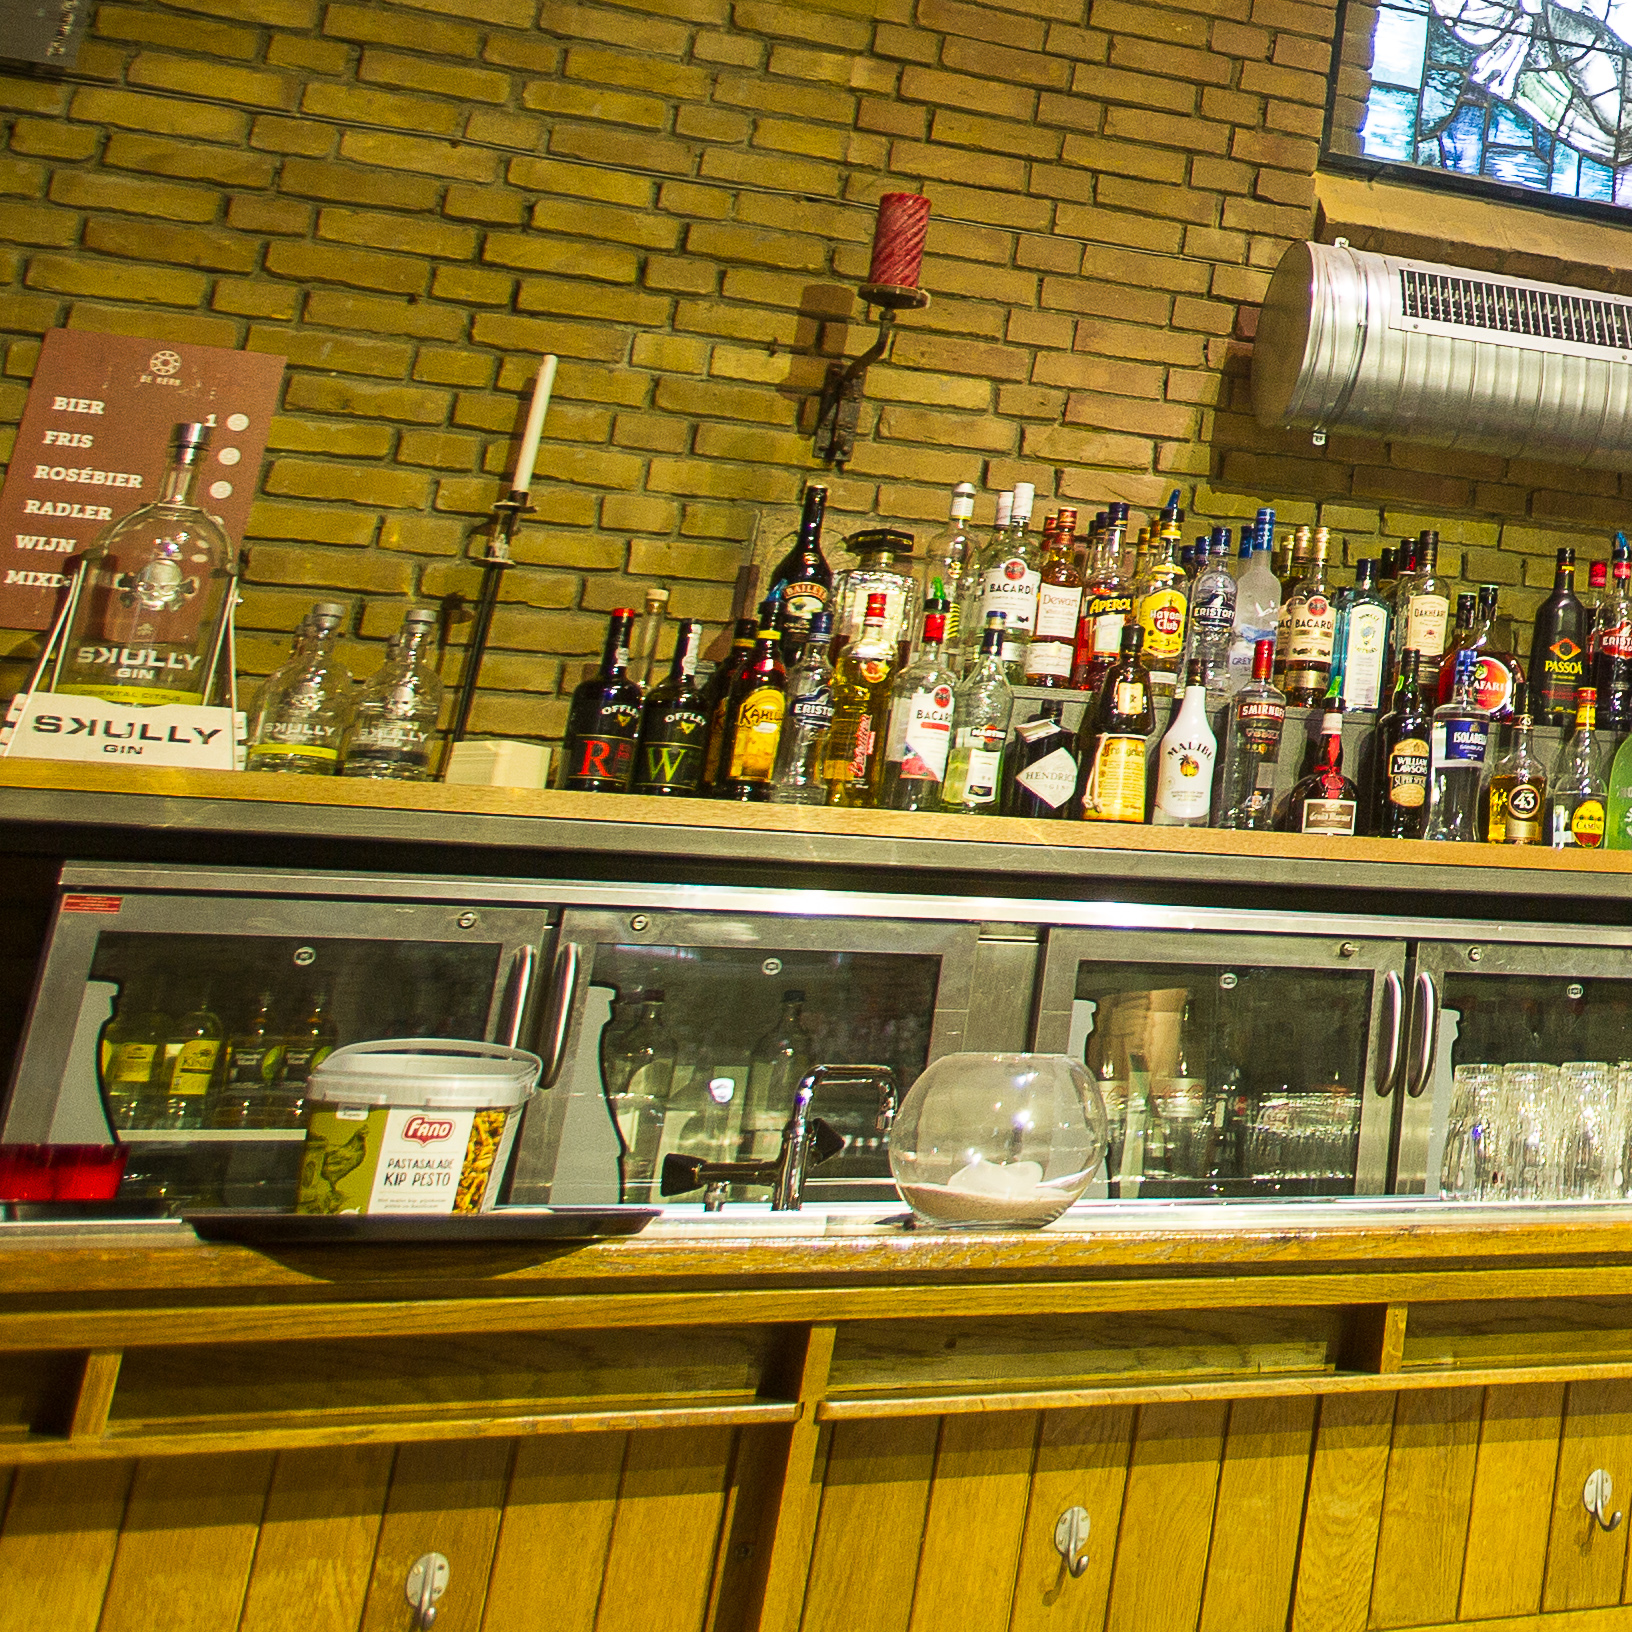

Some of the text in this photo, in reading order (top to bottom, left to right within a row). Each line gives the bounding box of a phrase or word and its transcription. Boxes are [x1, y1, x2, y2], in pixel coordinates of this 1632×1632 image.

[52, 396, 105, 414] BIER
[204, 413, 217, 427] 1
[42, 430, 94, 448] FRIS
[33, 464, 143, 489] ROSÉBIER
[23, 499, 113, 521] RADLER
[15, 534, 77, 553] WIJN
[77, 646, 201, 671] SKULLY
[116, 667, 154, 680] GIN
[1473, 680, 1505, 692] AFARI
[33, 714, 223, 745] SKULLY
[103, 744, 144, 755] GIN
[577, 740, 613, 777] R
[1167, 741, 1214, 761] MALIBU
[648, 747, 688, 783] W
[1513, 791, 1535, 809] 43
[384, 1172, 451, 1187] KIP PESTO
